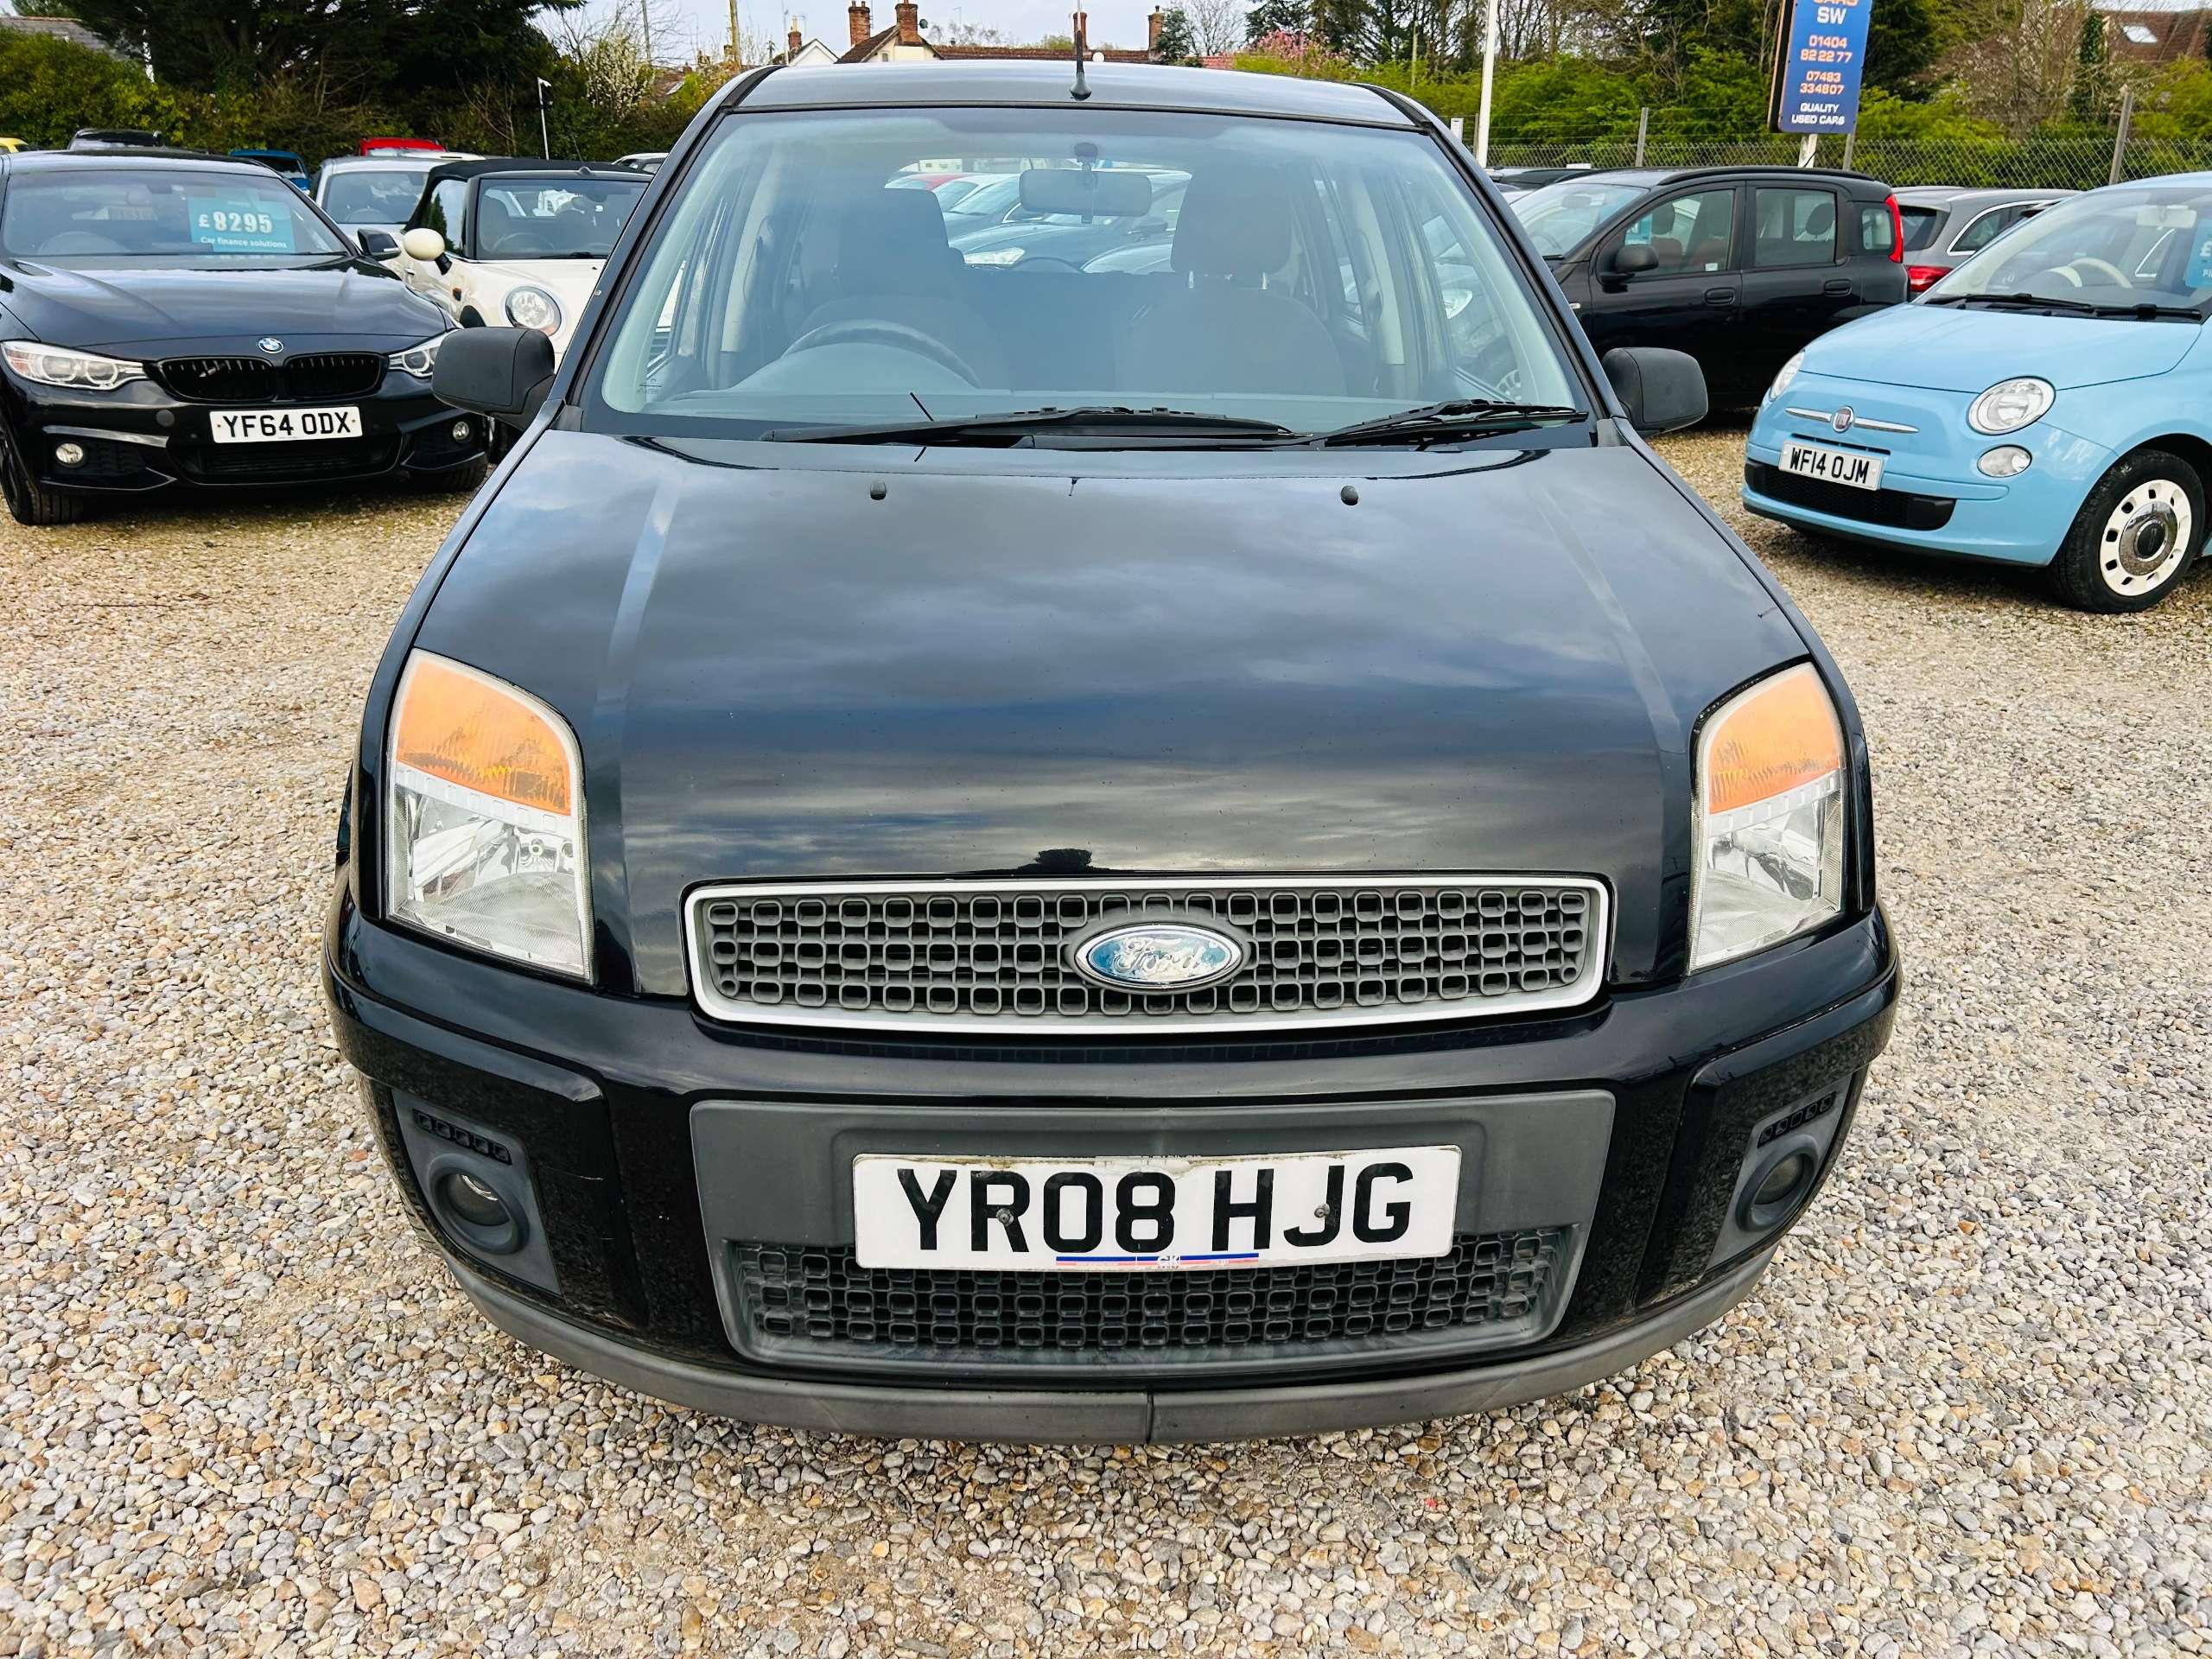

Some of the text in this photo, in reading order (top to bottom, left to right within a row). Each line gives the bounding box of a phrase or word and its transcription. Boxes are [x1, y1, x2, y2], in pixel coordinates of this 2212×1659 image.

[1817, 6, 1847, 24] SW
[1808, 35, 1847, 48] 01404
[1806, 71, 1841, 82] 07483
[1800, 83, 1845, 94] 334807
[1800, 103, 1840, 113] QUALITY
[1791, 114, 1846, 125] USED CARS
[217, 237, 249, 247] finance
[250, 240, 288, 249] solutions
[222, 411, 352, 438] YF64 ODX
[1789, 447, 1870, 484] WF14 OJM
[1113, 937, 1204, 973] Ford
[897, 1161, 1415, 1254] YR08 HJG
